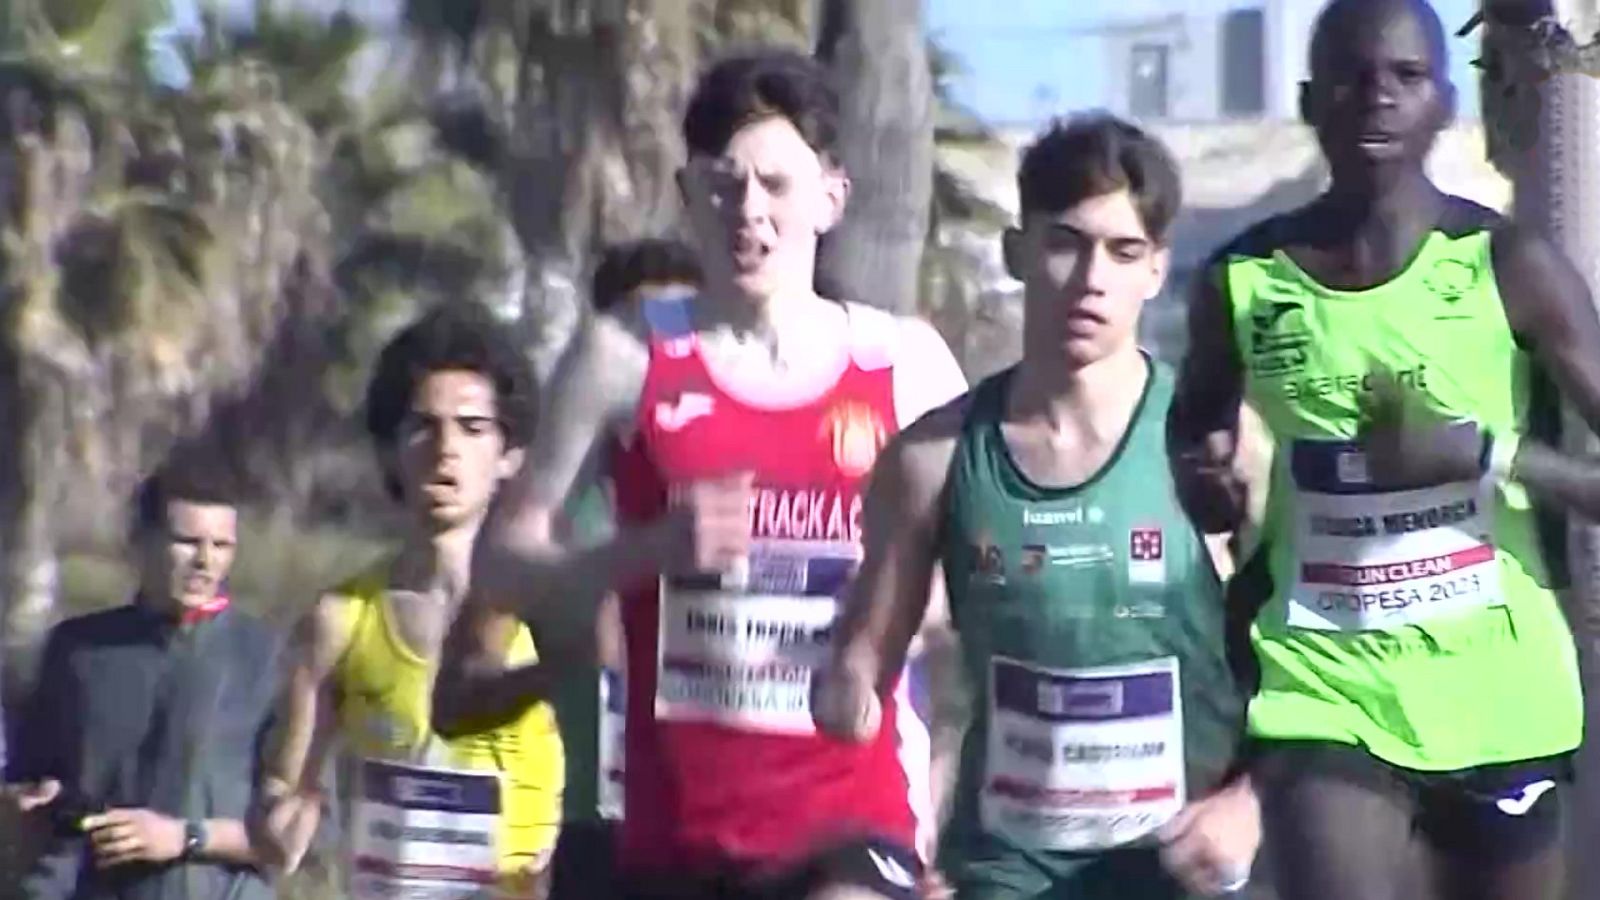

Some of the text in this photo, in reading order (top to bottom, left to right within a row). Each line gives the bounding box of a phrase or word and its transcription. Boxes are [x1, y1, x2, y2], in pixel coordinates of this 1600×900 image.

[749, 489, 825, 538] TRACK
[1388, 556, 1451, 581] CLEAN
[1317, 590, 1423, 611] OROPESA
